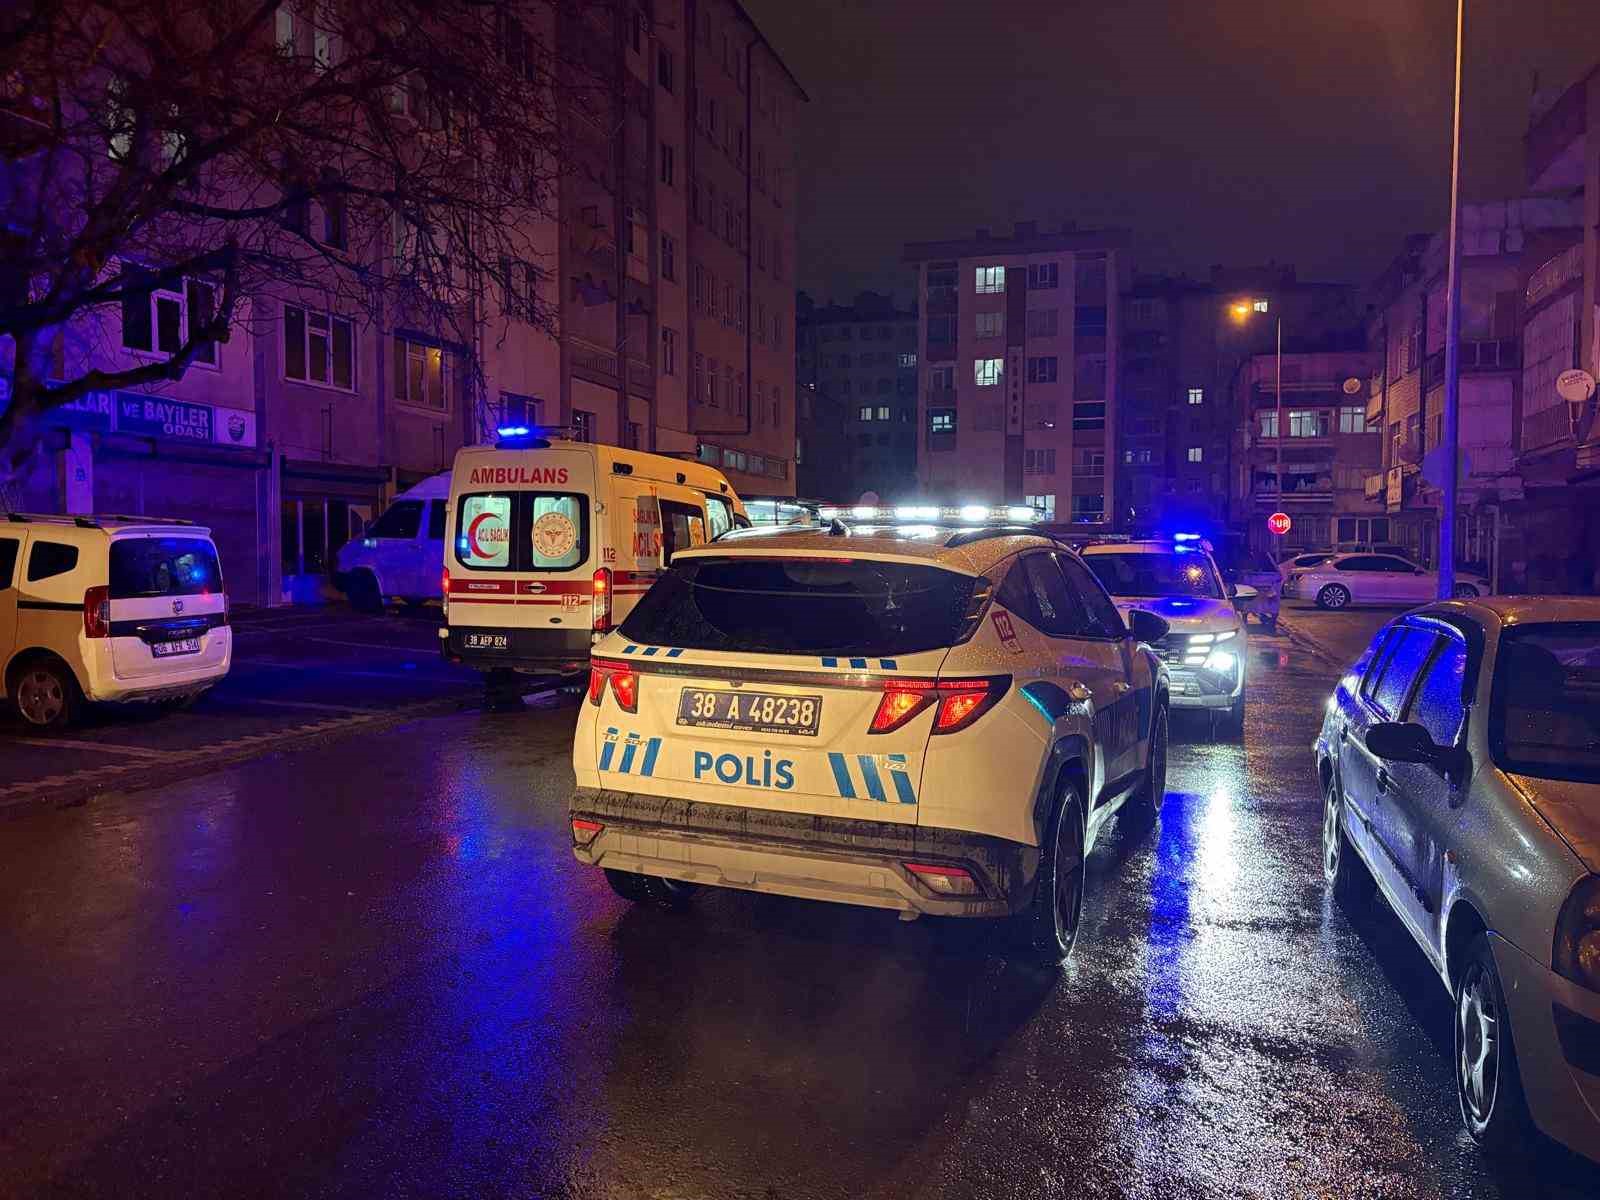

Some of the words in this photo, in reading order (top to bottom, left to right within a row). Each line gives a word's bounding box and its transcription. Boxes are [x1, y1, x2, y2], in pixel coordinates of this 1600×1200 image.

[122, 401, 140, 418] VE
[144, 400, 208, 428] BAYİLER
[163, 422, 208, 439] ODASI
[470, 467, 569, 484] AMBULANS
[1271, 519, 1288, 528] DUR
[603, 547, 616, 559] 112
[563, 595, 579, 606] 112
[691, 692, 716, 718] 38
[727, 695, 740, 720] A
[749, 696, 814, 726] 48238
[694, 749, 795, 790] POLİS
